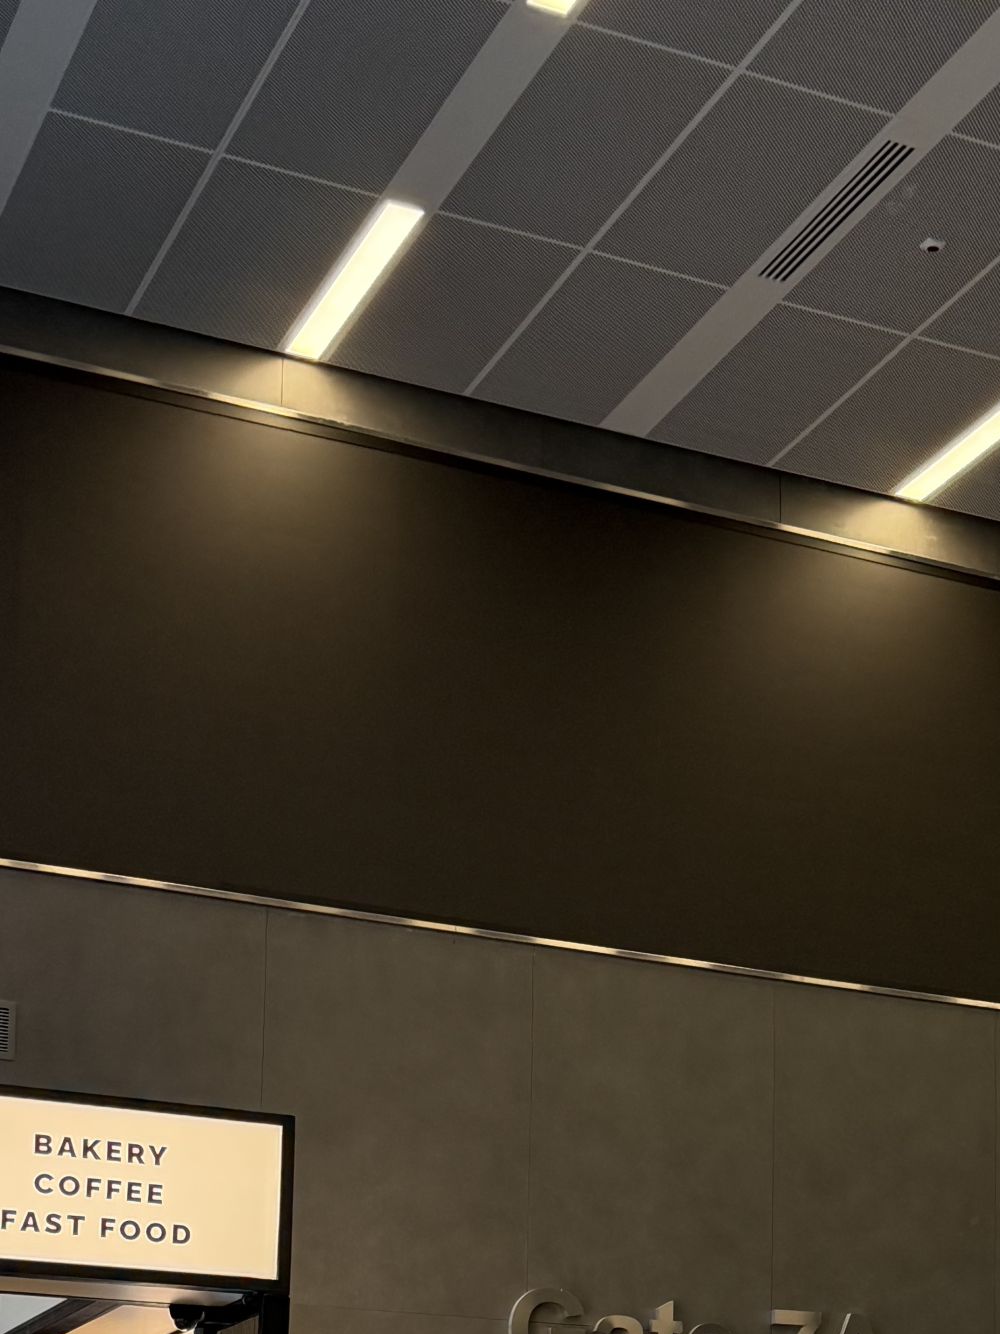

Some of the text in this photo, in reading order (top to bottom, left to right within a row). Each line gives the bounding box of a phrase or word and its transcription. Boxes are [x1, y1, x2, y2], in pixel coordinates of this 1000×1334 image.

[34, 1134, 167, 1166] BAKERY
[34, 1173, 163, 1205] COFFEE
[0, 1209, 191, 1245] FAST FOOD
